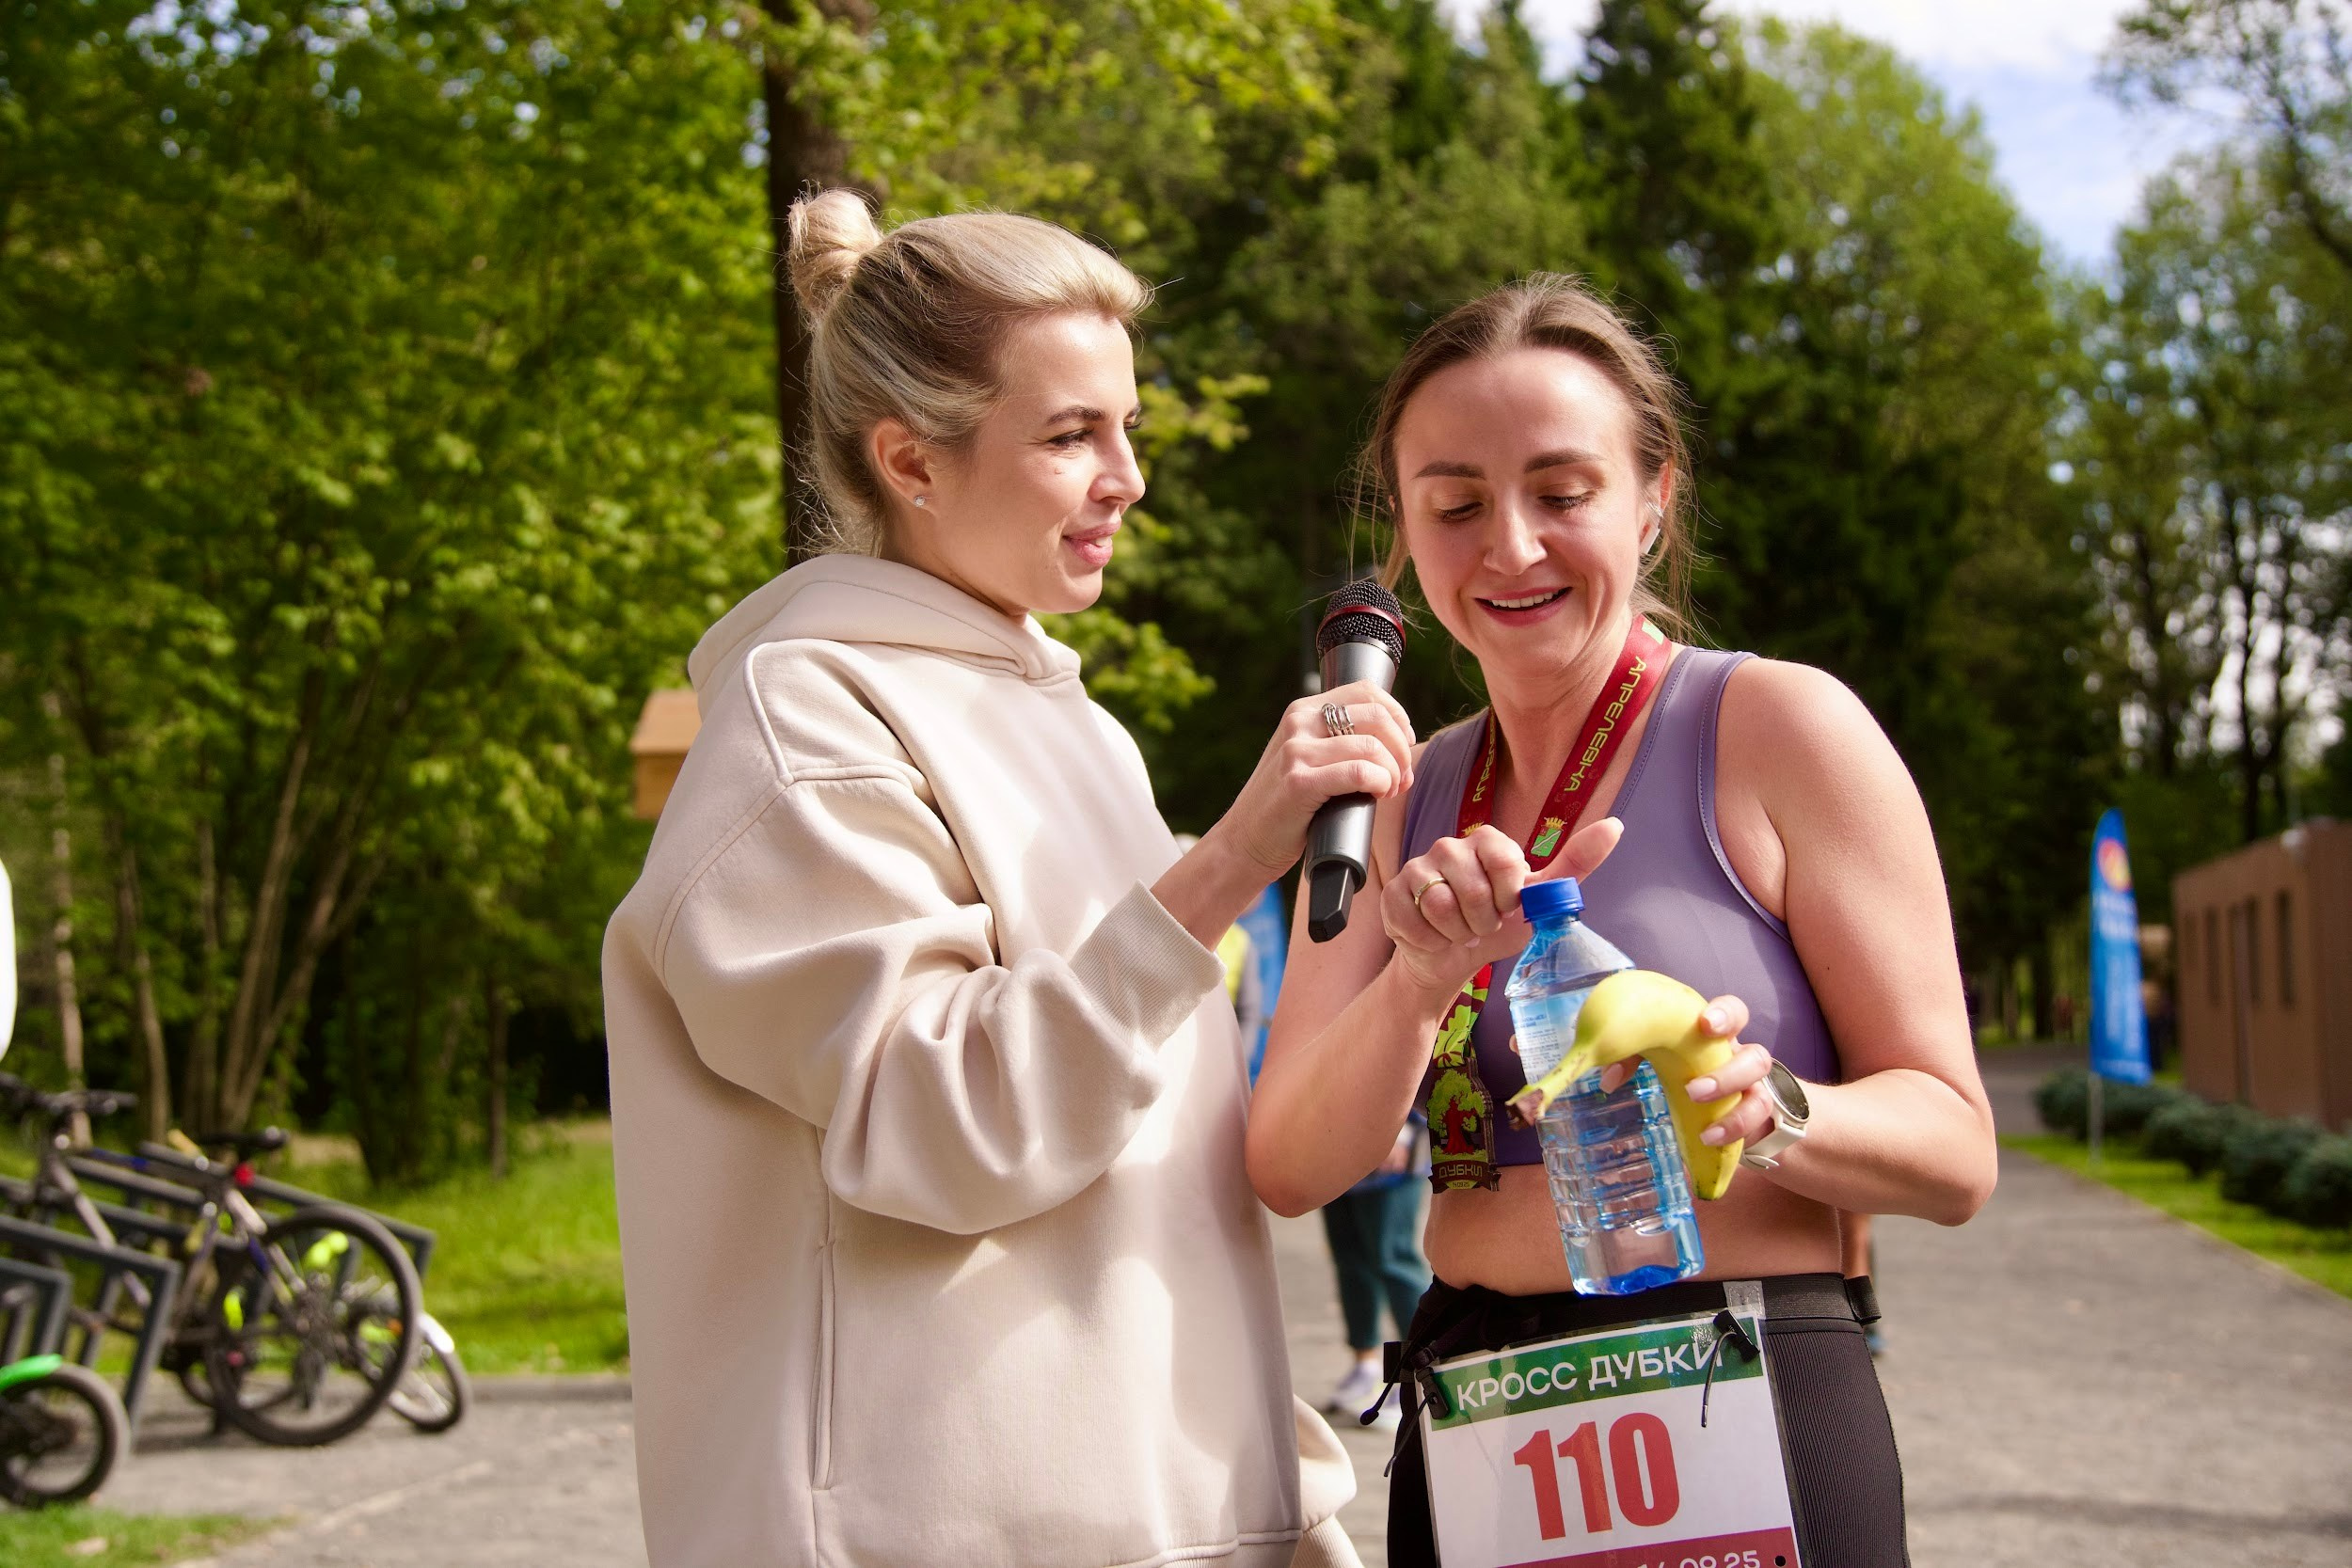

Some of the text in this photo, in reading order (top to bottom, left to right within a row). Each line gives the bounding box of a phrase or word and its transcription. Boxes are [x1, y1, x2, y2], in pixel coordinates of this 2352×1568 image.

[1564, 656, 1647, 792] АПРЕЛЕВКА
[1438, 1164, 1483, 1180] ДУБКИ
[1456, 1338, 1724, 1411] КРОСС ДУБКИ
[1513, 1412, 1680, 1541] 110
